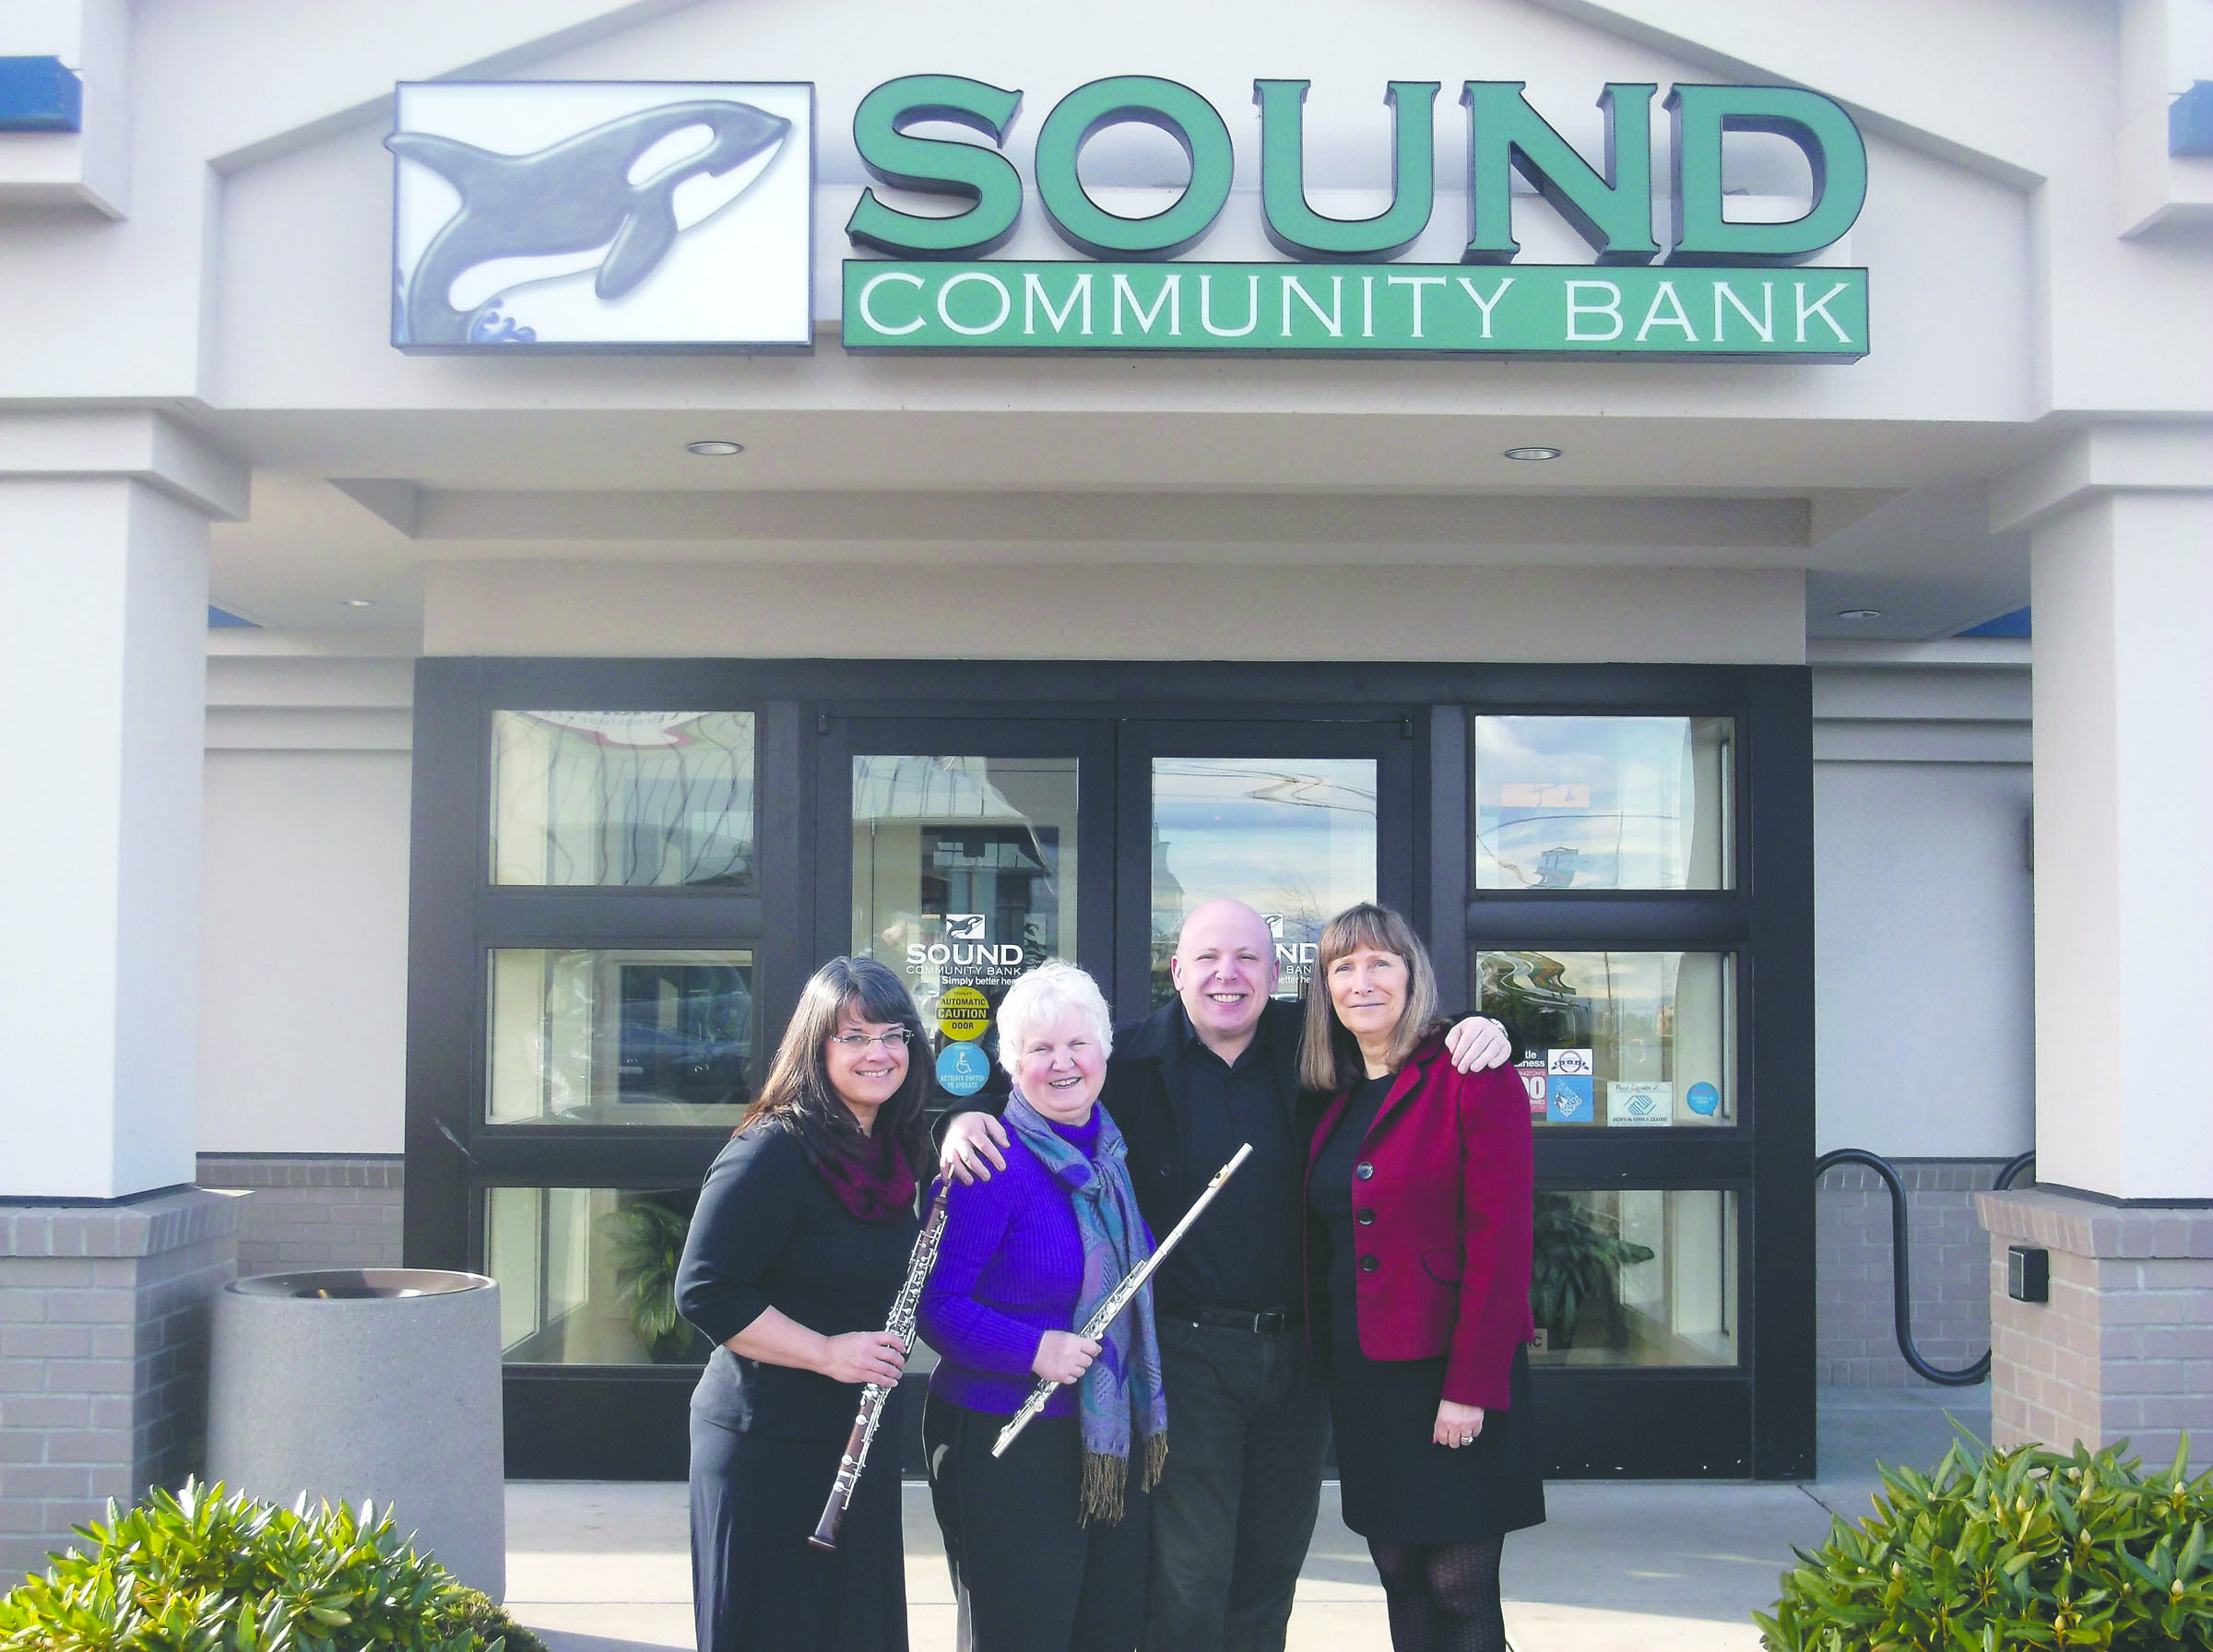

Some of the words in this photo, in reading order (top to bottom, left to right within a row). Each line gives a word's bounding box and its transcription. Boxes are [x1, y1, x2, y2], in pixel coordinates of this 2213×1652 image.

[846, 74, 1866, 262] SOUND
[859, 272, 1515, 338] COMMUNITY
[1564, 280, 1852, 344] BANK
[906, 943, 1024, 965] SOUND
[906, 966, 982, 975] COMMUNITY
[987, 966, 1021, 975] BANK
[1286, 966, 1311, 974] BAN
[941, 976, 974, 986] Simply
[976, 976, 1000, 985] better
[1300, 974, 1311, 984] he
[938, 1009, 987, 1019] CAUTION
[952, 1021, 974, 1030] DOOR
